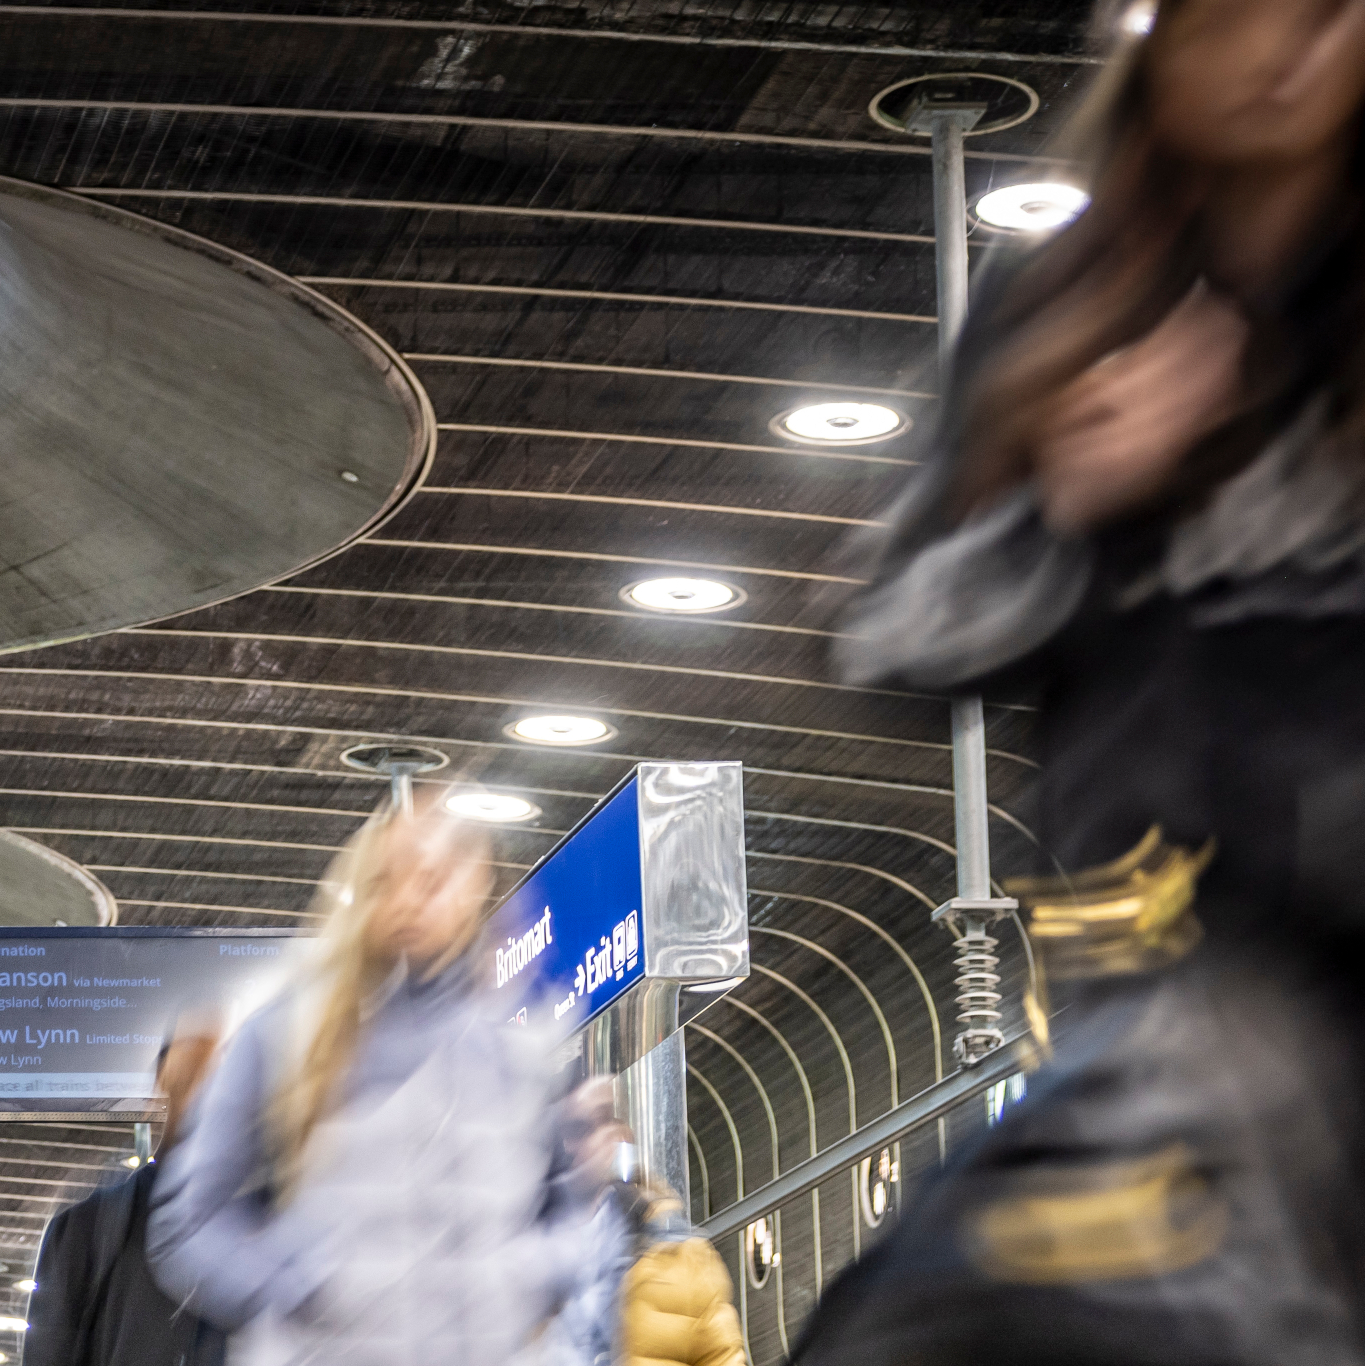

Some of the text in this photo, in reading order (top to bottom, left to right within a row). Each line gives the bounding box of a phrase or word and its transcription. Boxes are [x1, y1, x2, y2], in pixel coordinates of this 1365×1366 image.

[219, 944, 279, 956] Platform
[495, 904, 553, 989] Britomart
[585, 935, 613, 994] Exit
[73, 977, 91, 988] via
[93, 977, 162, 988] Newmarket
[25, 1026, 80, 1049] Lynn
[86, 1033, 130, 1045] Limited
[11, 1054, 42, 1069] Lynn
